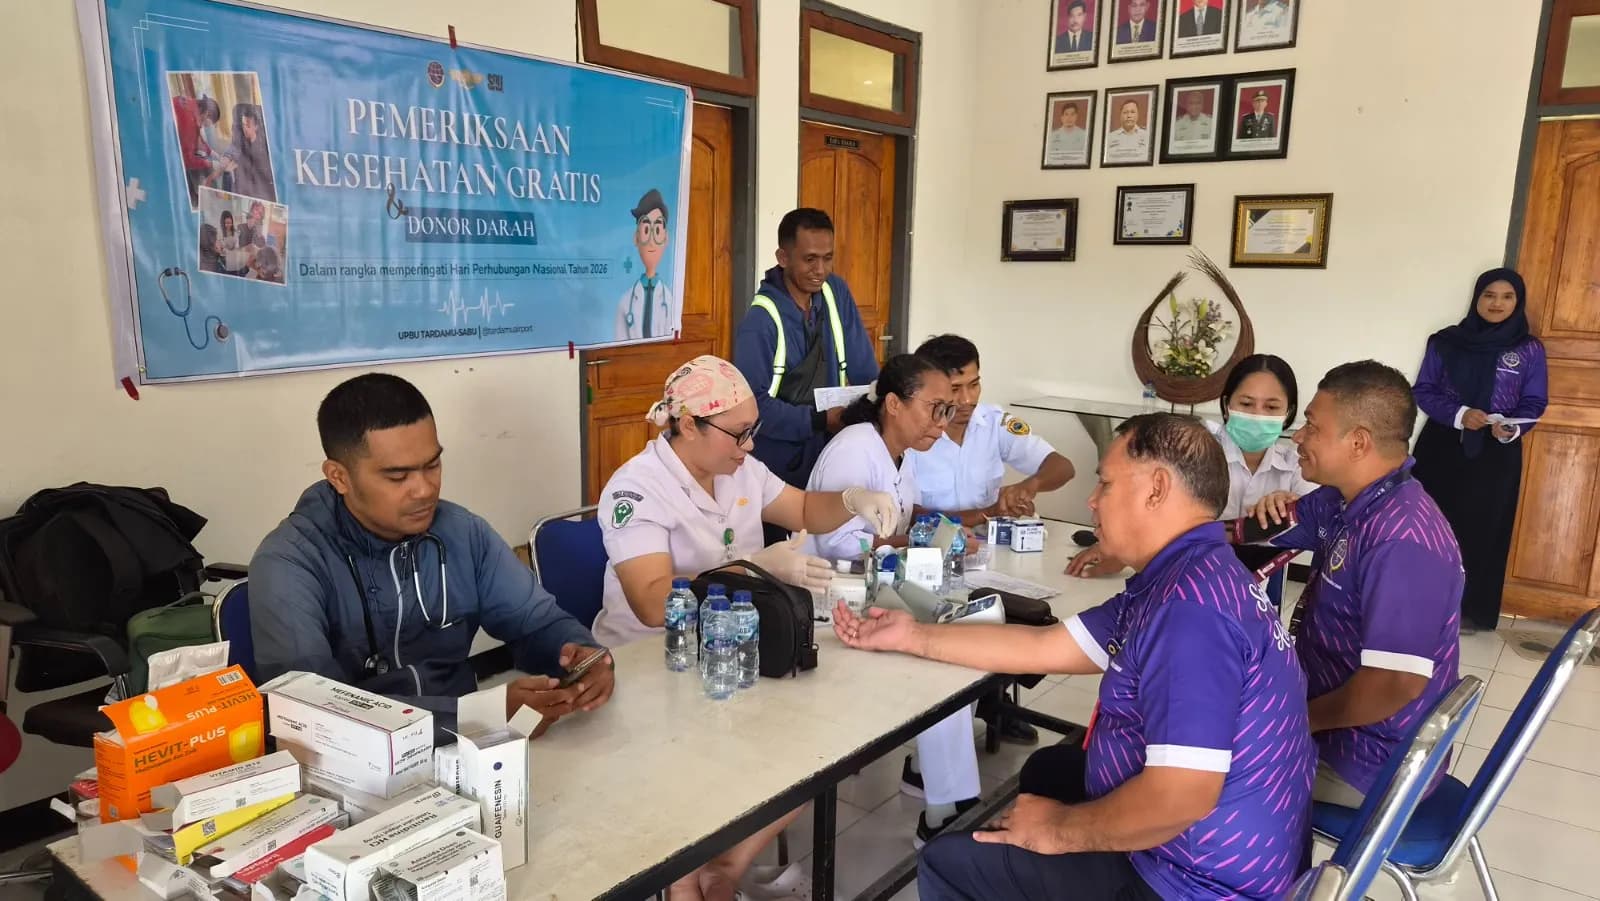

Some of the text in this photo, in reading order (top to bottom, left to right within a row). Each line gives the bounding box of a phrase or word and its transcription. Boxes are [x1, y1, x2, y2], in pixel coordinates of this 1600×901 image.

[347, 98, 571, 156] PEMERIKSAAN
[294, 149, 601, 203] KESEHATAN GRATIS
[386, 182, 408, 219] &
[408, 215, 535, 238] DONOR DARAH
[299, 262, 608, 280] Dalam rangka memperingati Hari Perhubungan Nasional Tahun 2026
[398, 327, 477, 340] UPBU TARDAMU-SABU
[133, 726, 227, 768] HEVIT-PLUS
[494, 779, 503, 839] GUAIFENESIN
